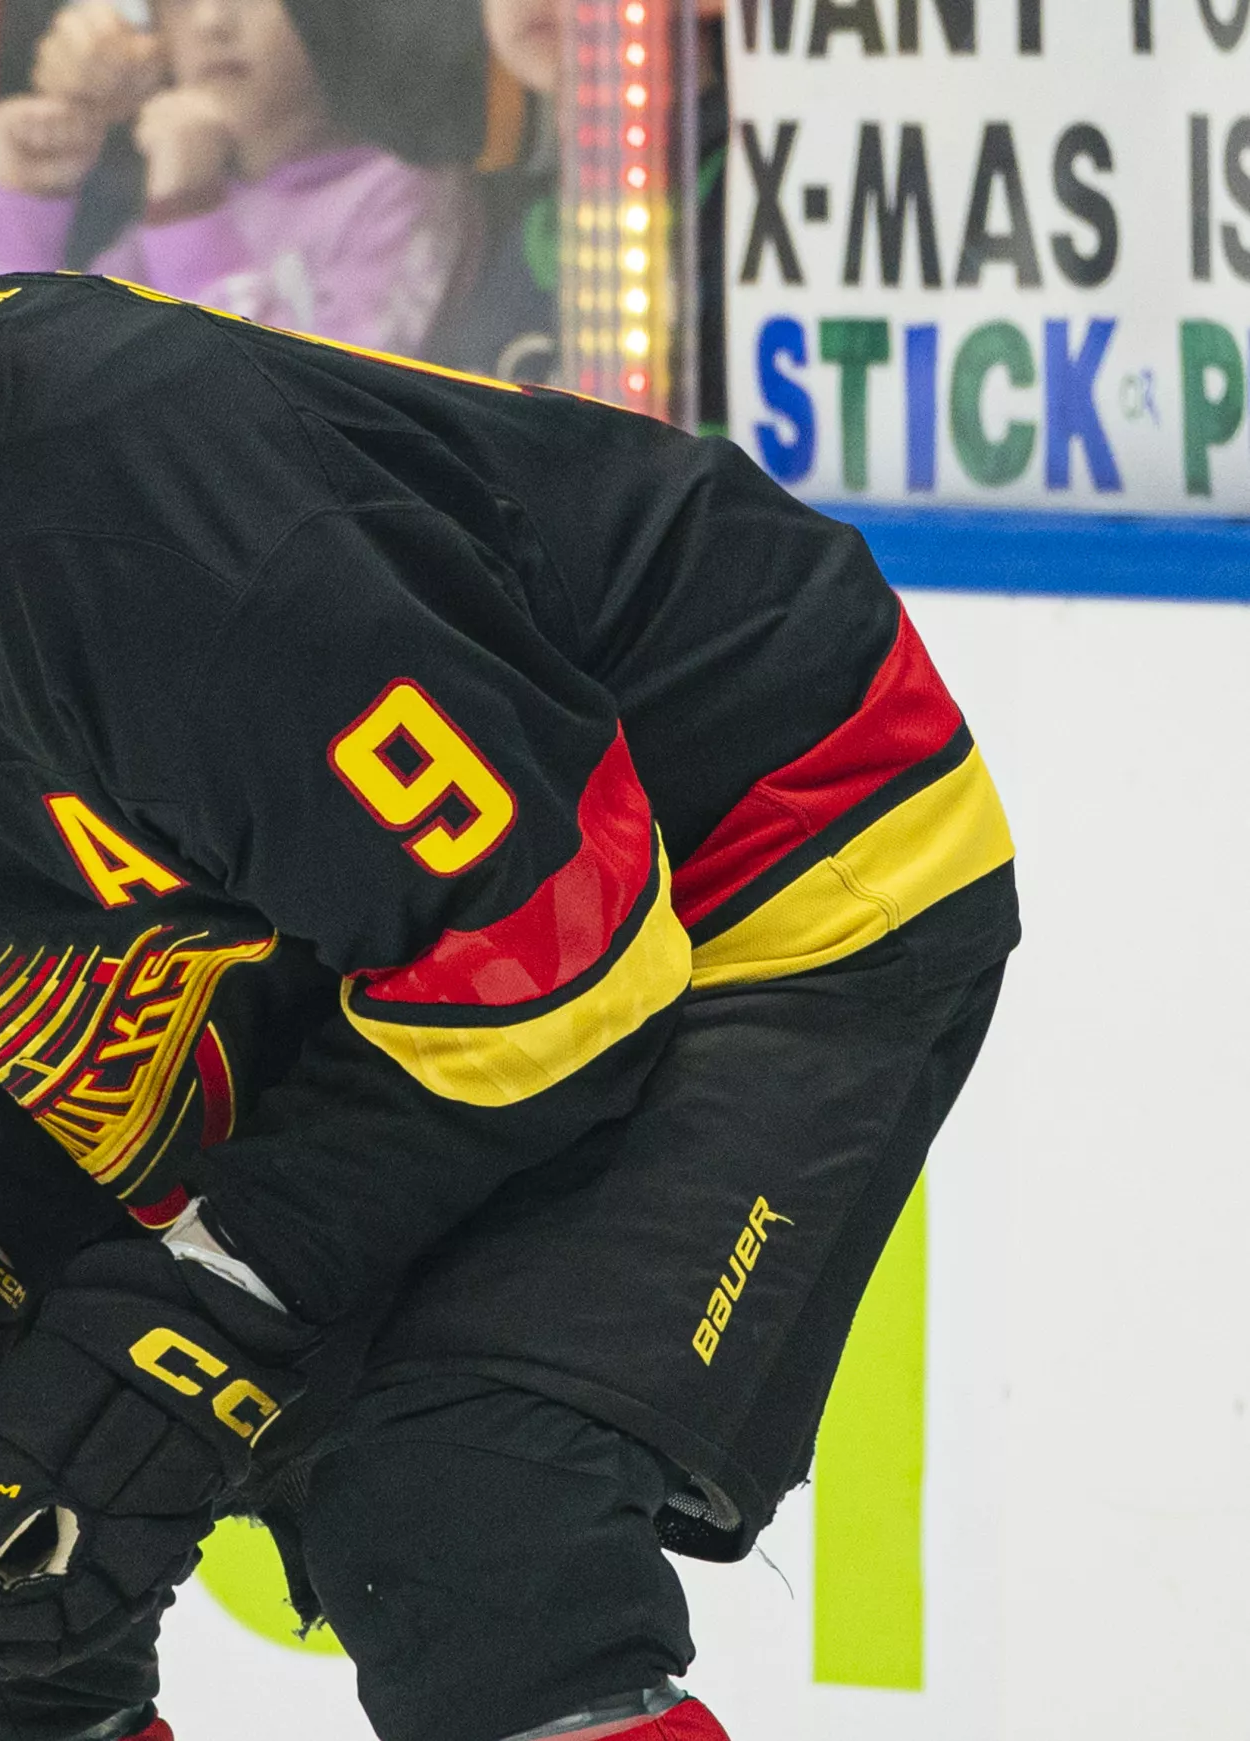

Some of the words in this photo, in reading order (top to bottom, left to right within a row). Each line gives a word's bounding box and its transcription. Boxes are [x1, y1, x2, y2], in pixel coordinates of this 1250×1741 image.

[740, 118, 1120, 289] X-MAS
[753, 314, 1124, 494] STICK
[1180, 317, 1250, 496] P
[42, 791, 190, 909] A
[327, 676, 518, 878] 9
[128, 1327, 282, 1449] CC
